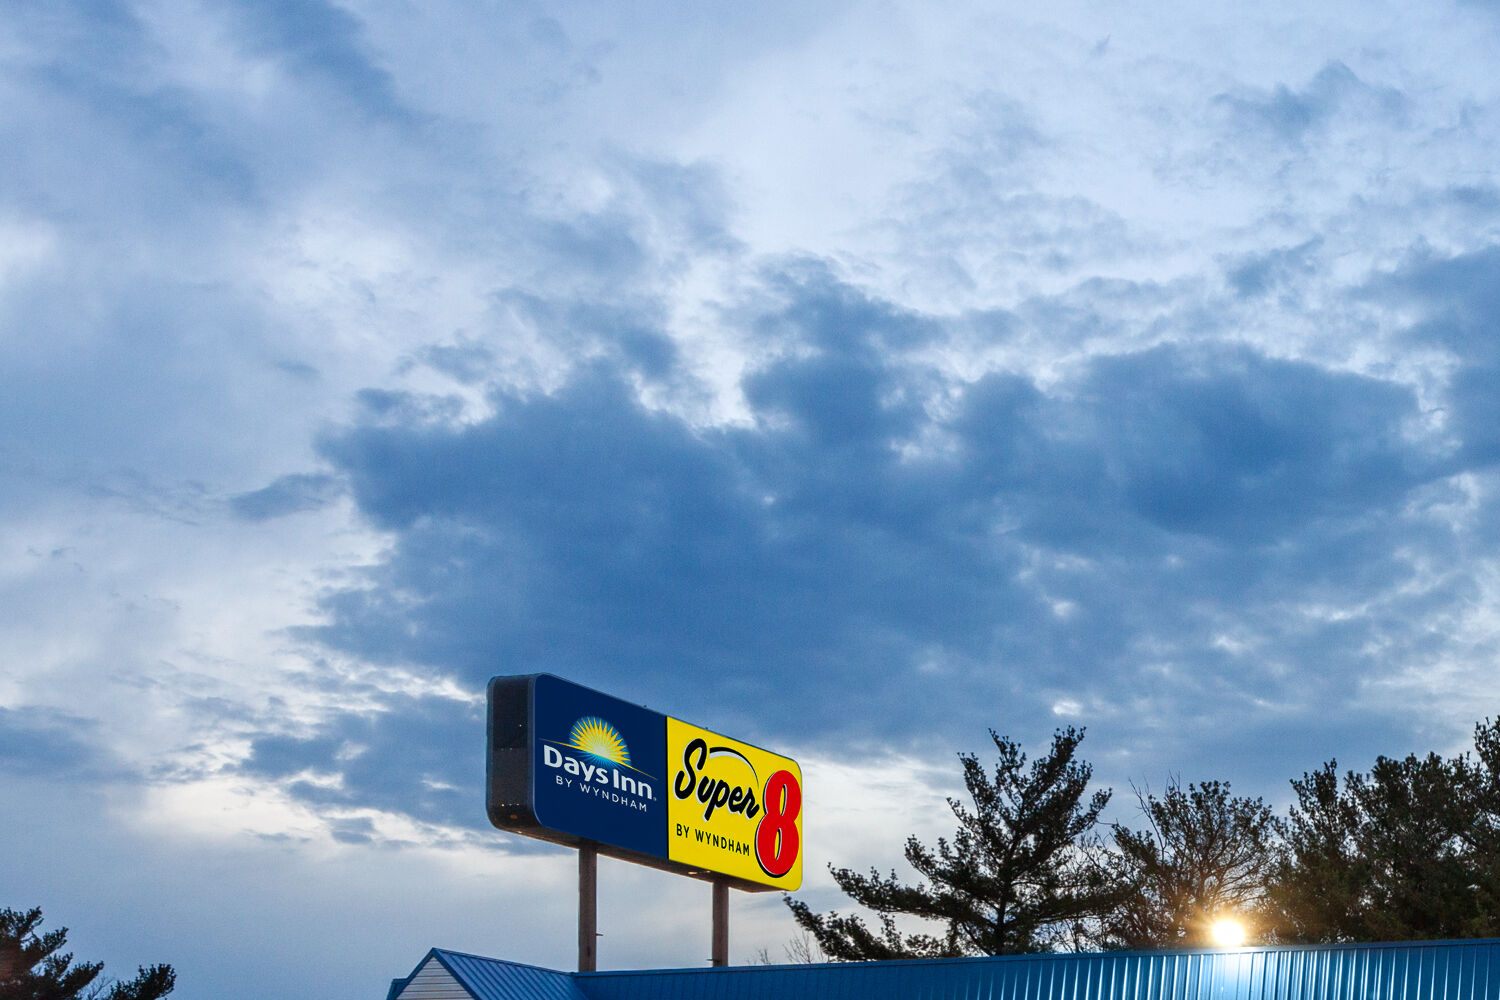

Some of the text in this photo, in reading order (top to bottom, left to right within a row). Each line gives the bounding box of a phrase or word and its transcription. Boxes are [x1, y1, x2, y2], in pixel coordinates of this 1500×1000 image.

[543, 744, 653, 800] Days Inn
[555, 775, 647, 813] BY WYNDHAM
[673, 738, 802, 879] Super 8
[676, 823, 750, 857] BY WYNDHAM
